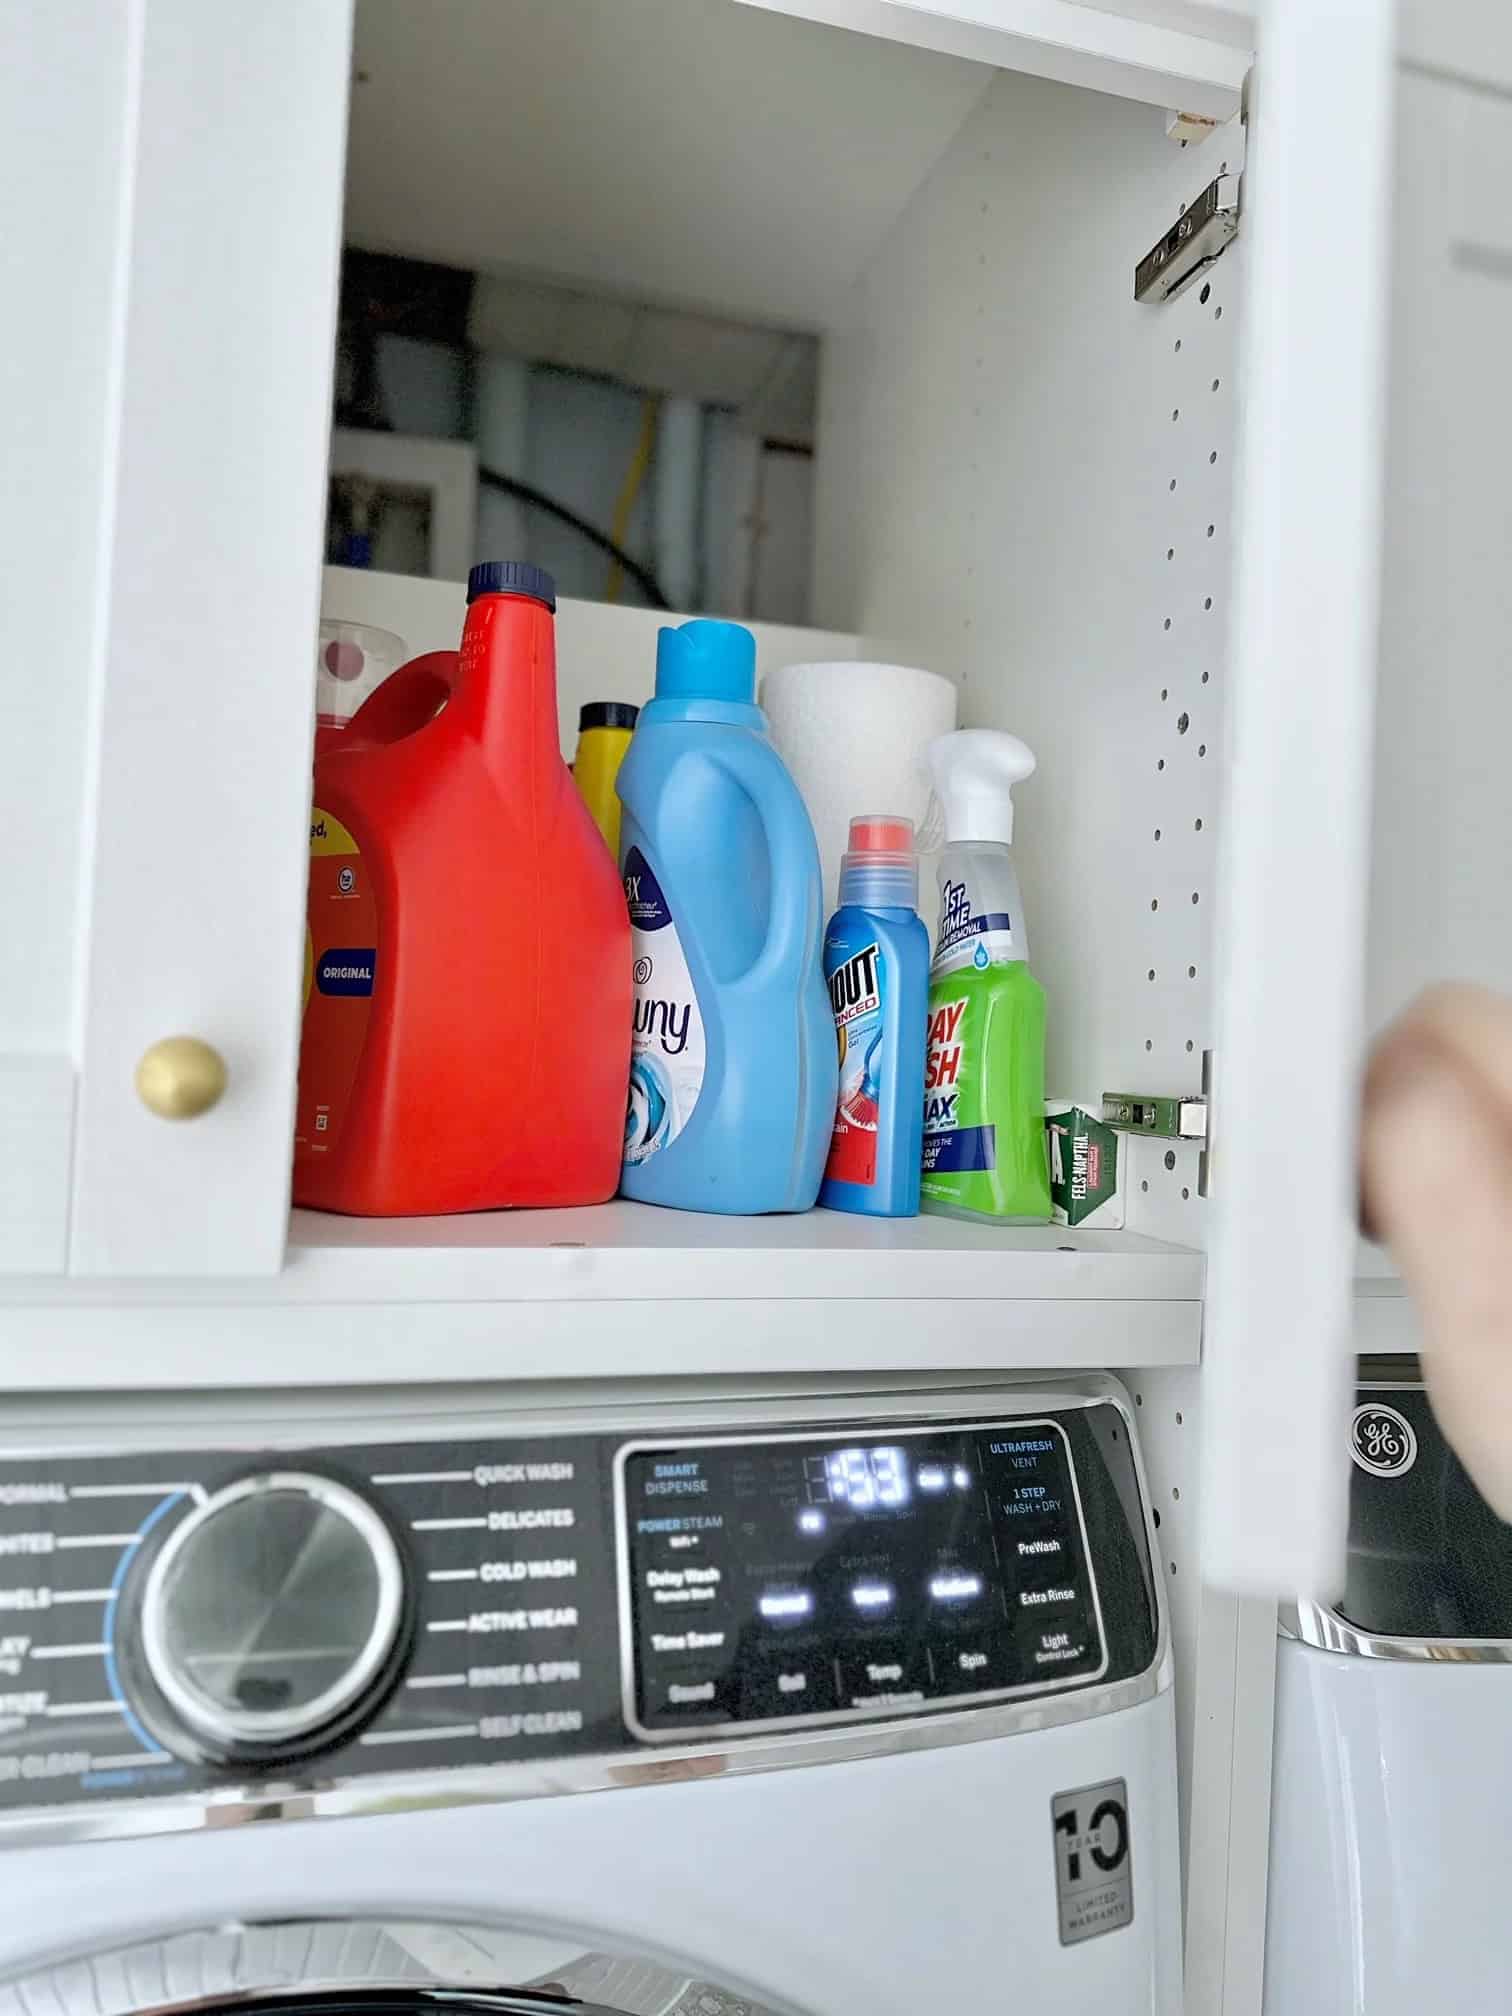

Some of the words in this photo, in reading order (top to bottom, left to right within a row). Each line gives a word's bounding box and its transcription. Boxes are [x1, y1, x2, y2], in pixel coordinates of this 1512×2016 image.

[323, 966, 372, 979] ORIGINAL
[828, 944, 878, 1014] OUT
[990, 1440, 1054, 1455] ULTRAFRESH
[1011, 1456, 1038, 1469] VENT
[645, 1480, 708, 1496] DISPENSE
[1021, 1487, 1047, 1499] STEP
[1003, 1502, 1034, 1516] WASH
[1041, 1499, 1063, 1512] DRY
[488, 1508, 576, 1530] DELICATES
[681, 1515, 723, 1531] STEAM
[1018, 1540, 1061, 1555] PreWash
[480, 1561, 527, 1582] COLD
[1020, 1592, 1047, 1606] Extra
[1047, 1588, 1076, 1602] Rinse
[467, 1610, 528, 1632] ACTIVE
[528, 1607, 579, 1629] WEAR
[1041, 1633, 1069, 1649] Light
[959, 1652, 987, 1670] Spin
[1055, 1799, 1129, 1882] 10
